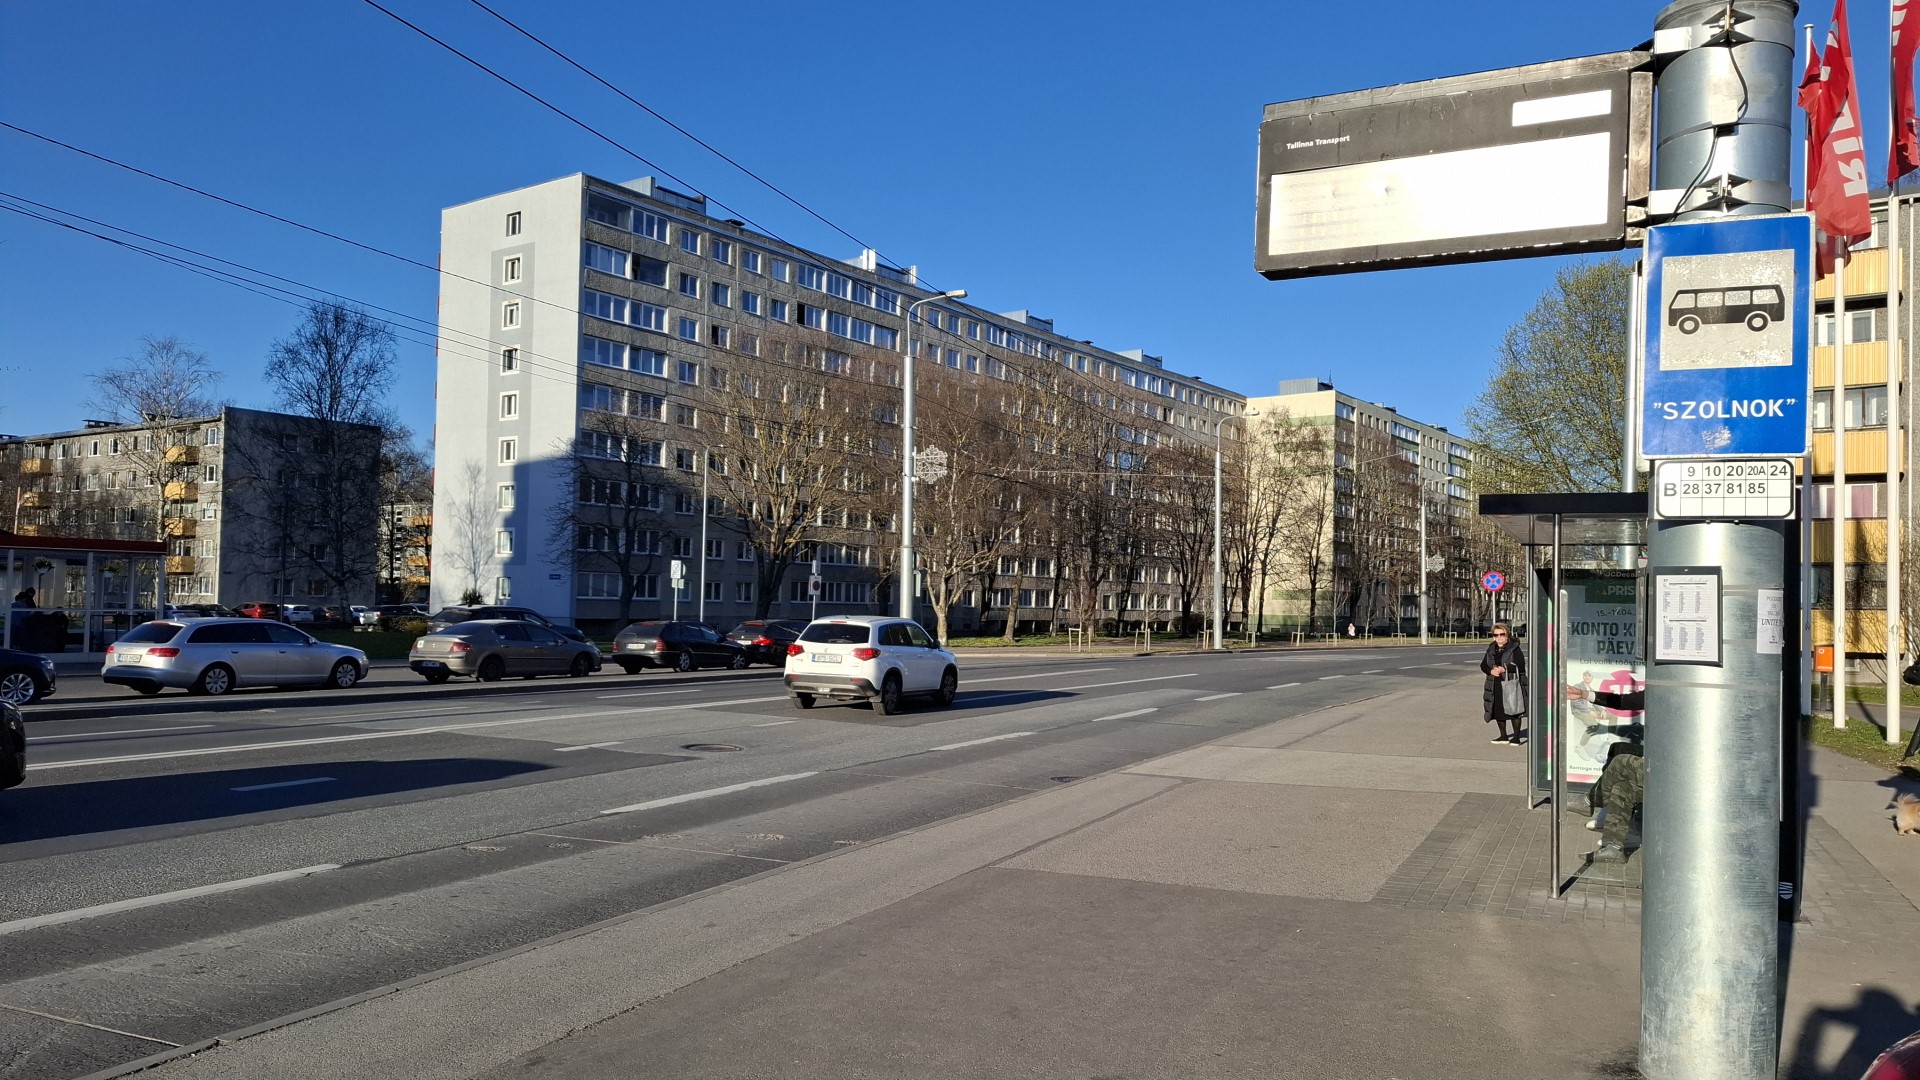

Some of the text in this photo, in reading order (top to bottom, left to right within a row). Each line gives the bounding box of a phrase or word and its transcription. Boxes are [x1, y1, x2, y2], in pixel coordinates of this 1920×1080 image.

[1286, 135, 1350, 150] Tallinna Transport
[1687, 465, 1788, 477] 9 10 20 20A 24
[1663, 482, 1678, 497] B
[1682, 482, 1766, 495] 28 37 81 85
[1608, 585, 1635, 596] PRIS
[1571, 621, 1619, 637] KONTO
[1597, 637, 1636, 655] PÄEV
